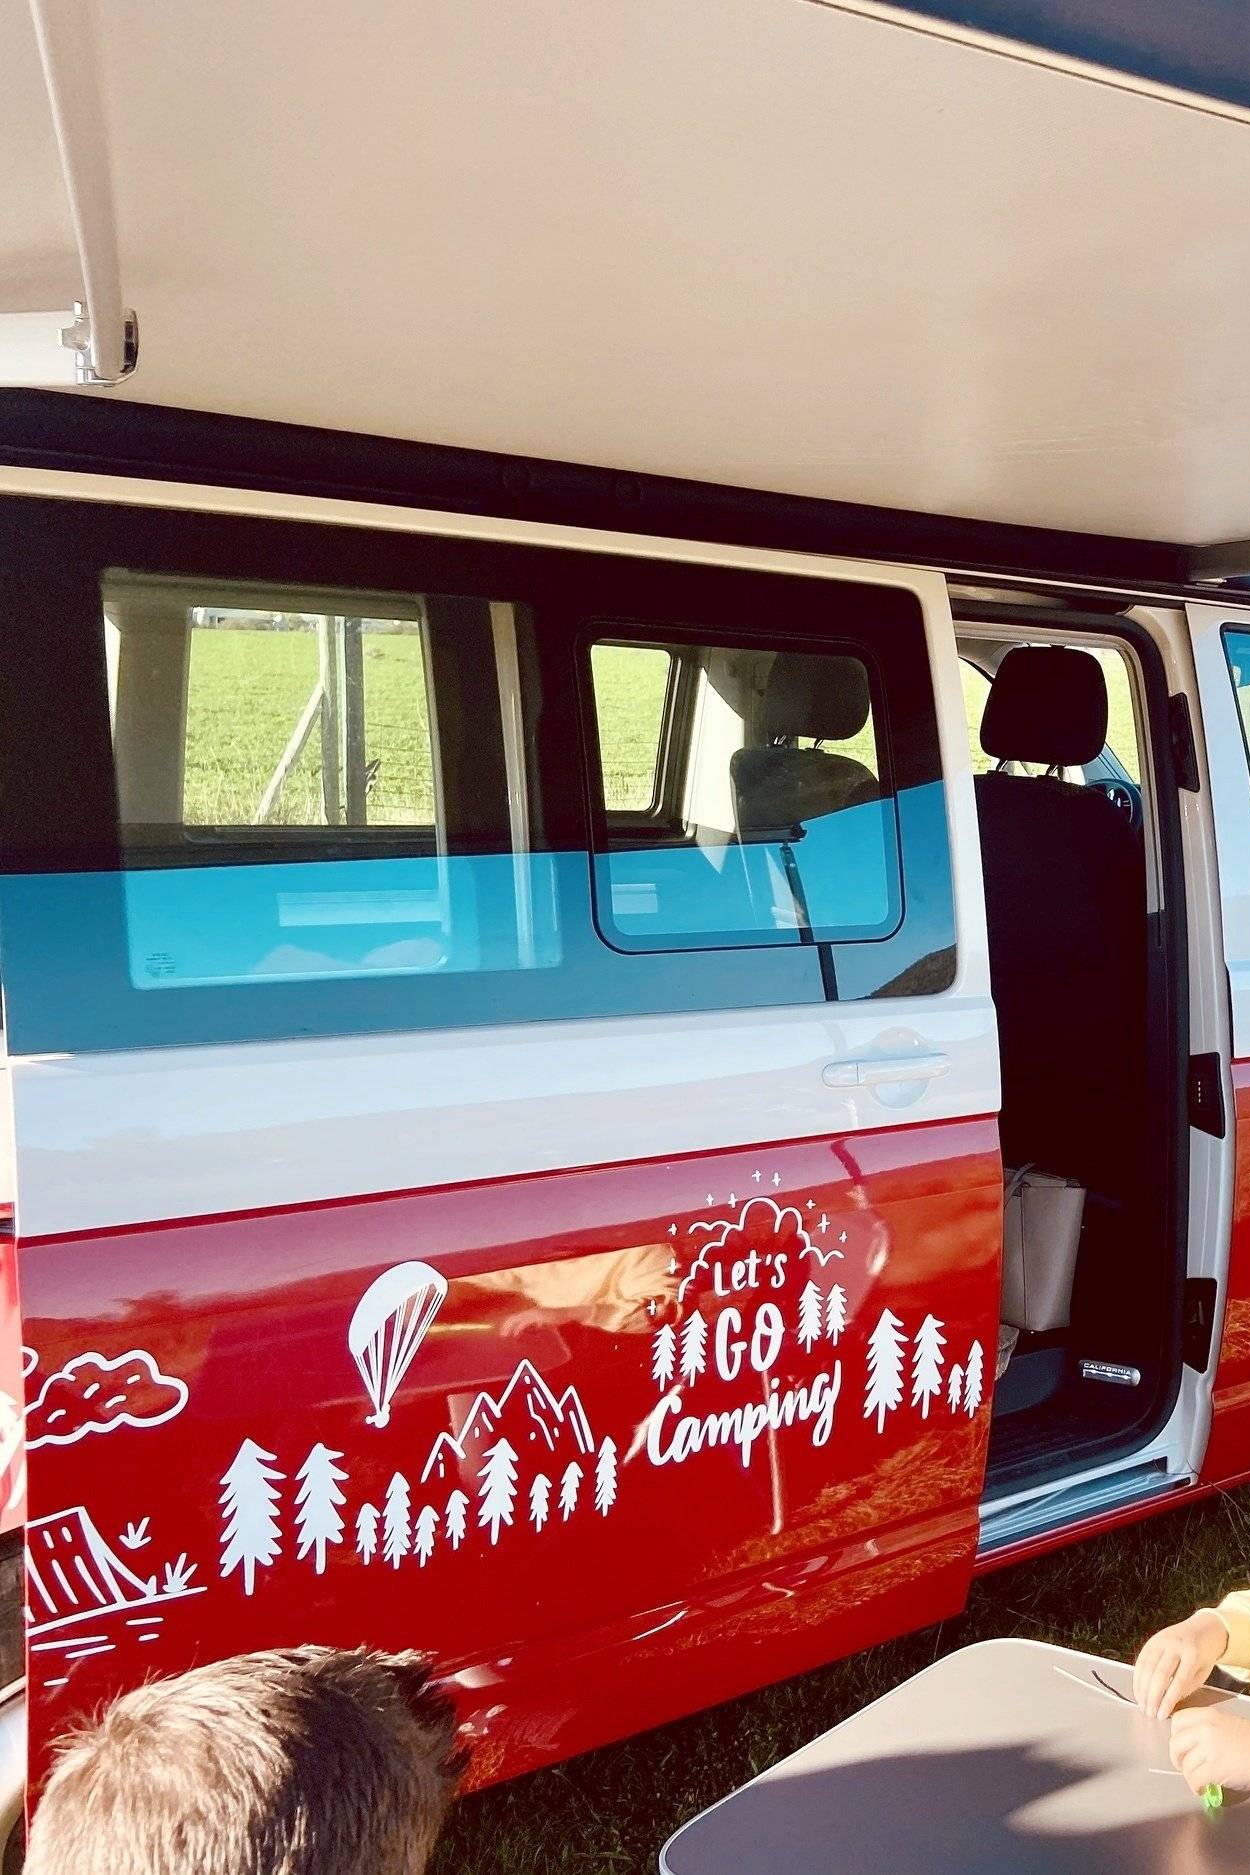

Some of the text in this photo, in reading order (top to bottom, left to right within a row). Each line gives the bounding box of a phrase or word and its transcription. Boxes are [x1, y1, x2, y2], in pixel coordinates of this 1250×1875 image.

[713, 1250, 787, 1296] Let's
[715, 1303, 786, 1381] GO
[1083, 1362, 1132, 1375] CALIFORNIA
[647, 1360, 841, 1468] Camping
